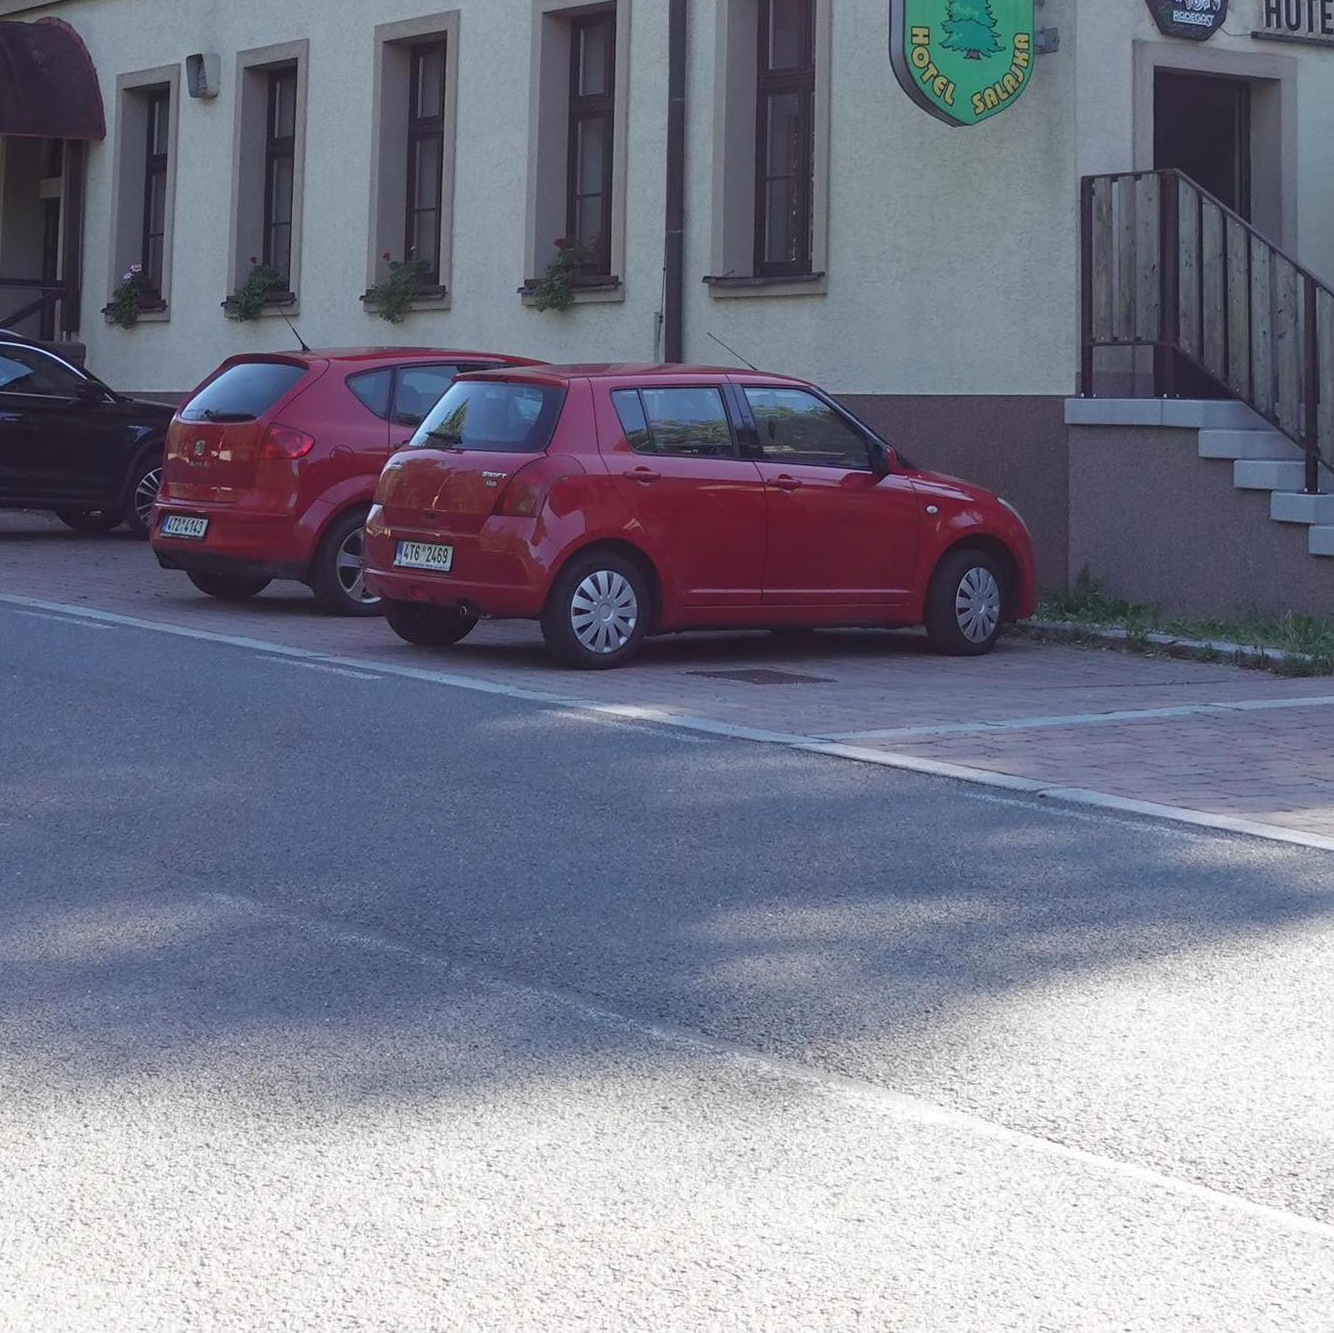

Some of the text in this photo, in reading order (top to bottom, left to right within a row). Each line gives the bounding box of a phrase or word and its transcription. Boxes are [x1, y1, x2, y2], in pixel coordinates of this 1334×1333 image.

[1172, 10, 1215, 27] RADEGAST
[911, 26, 1030, 116] HOTEL SALAJKA
[403, 544, 448, 565] 4T6 2469
